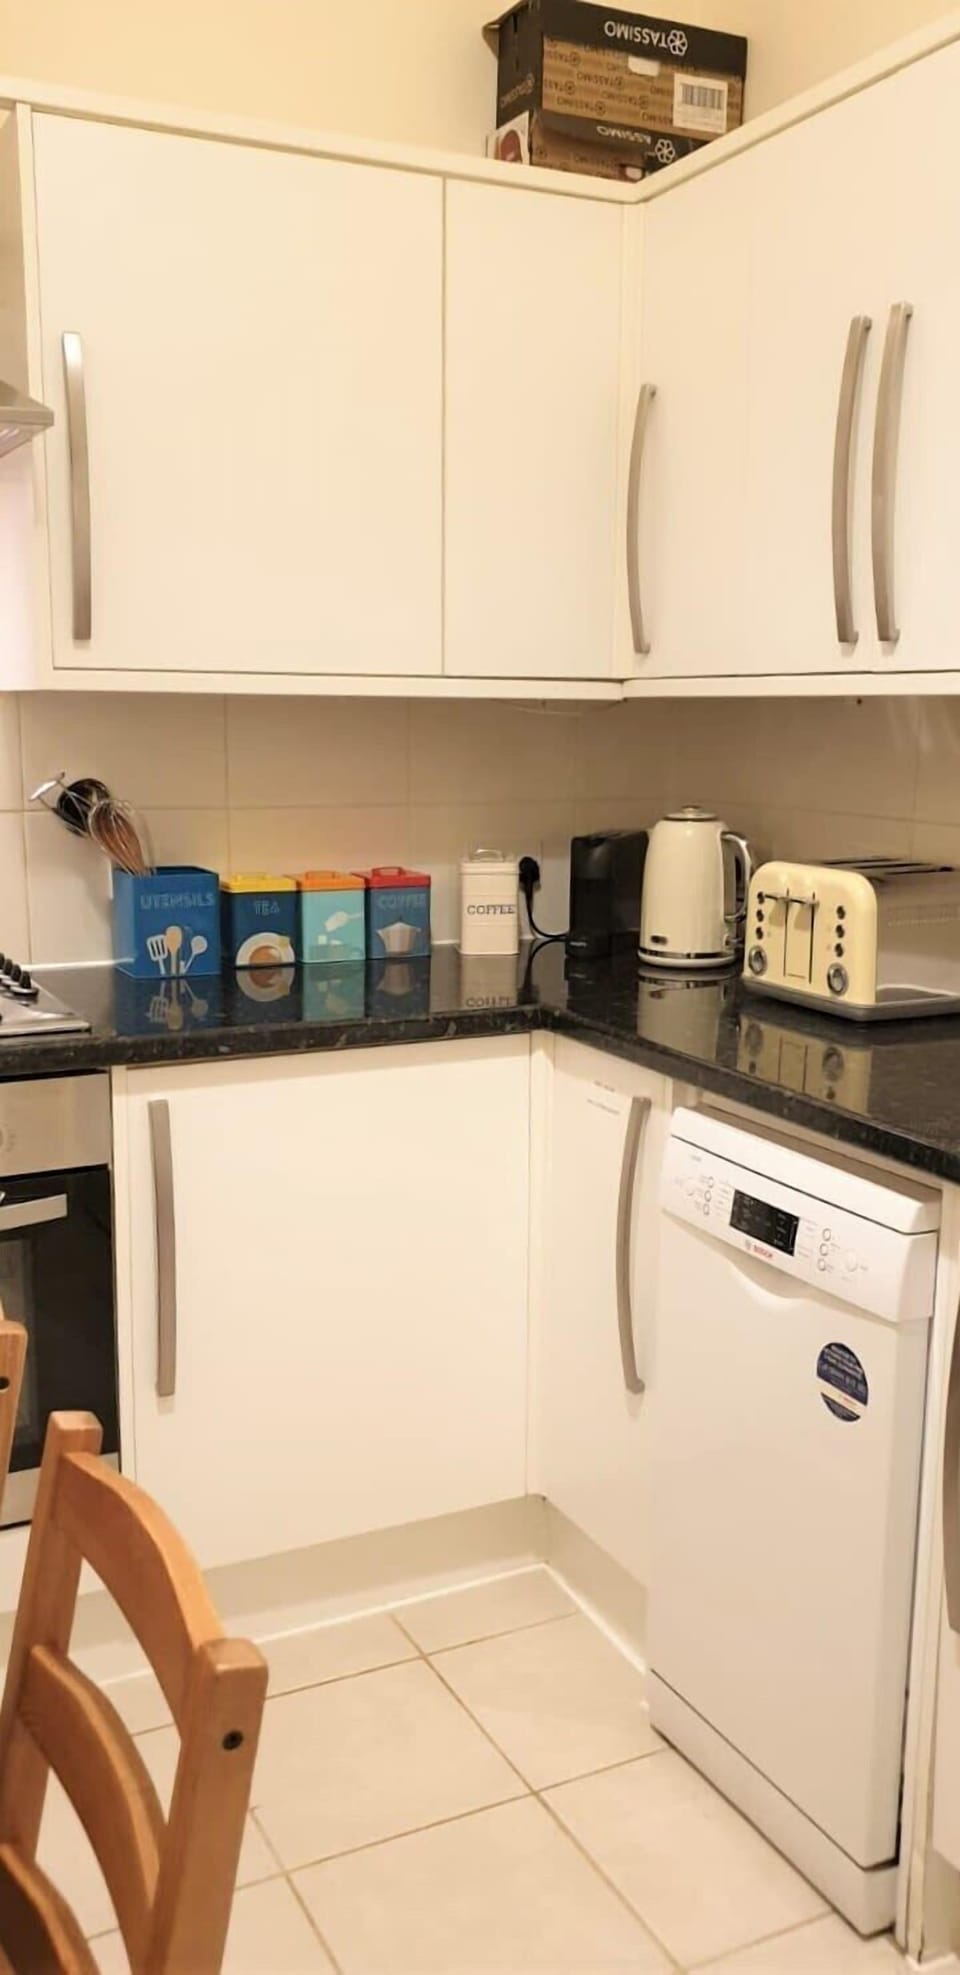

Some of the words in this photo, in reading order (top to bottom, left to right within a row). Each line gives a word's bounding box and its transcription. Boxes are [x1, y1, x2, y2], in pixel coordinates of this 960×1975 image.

[604, 20, 668, 49] TASSIMO
[597, 125, 652, 144] ASSIMO
[140, 892, 215, 910] UTENSILS
[255, 901, 280, 916] TEA
[380, 892, 427, 908] COFFEE
[467, 904, 516, 916] COFFEE
